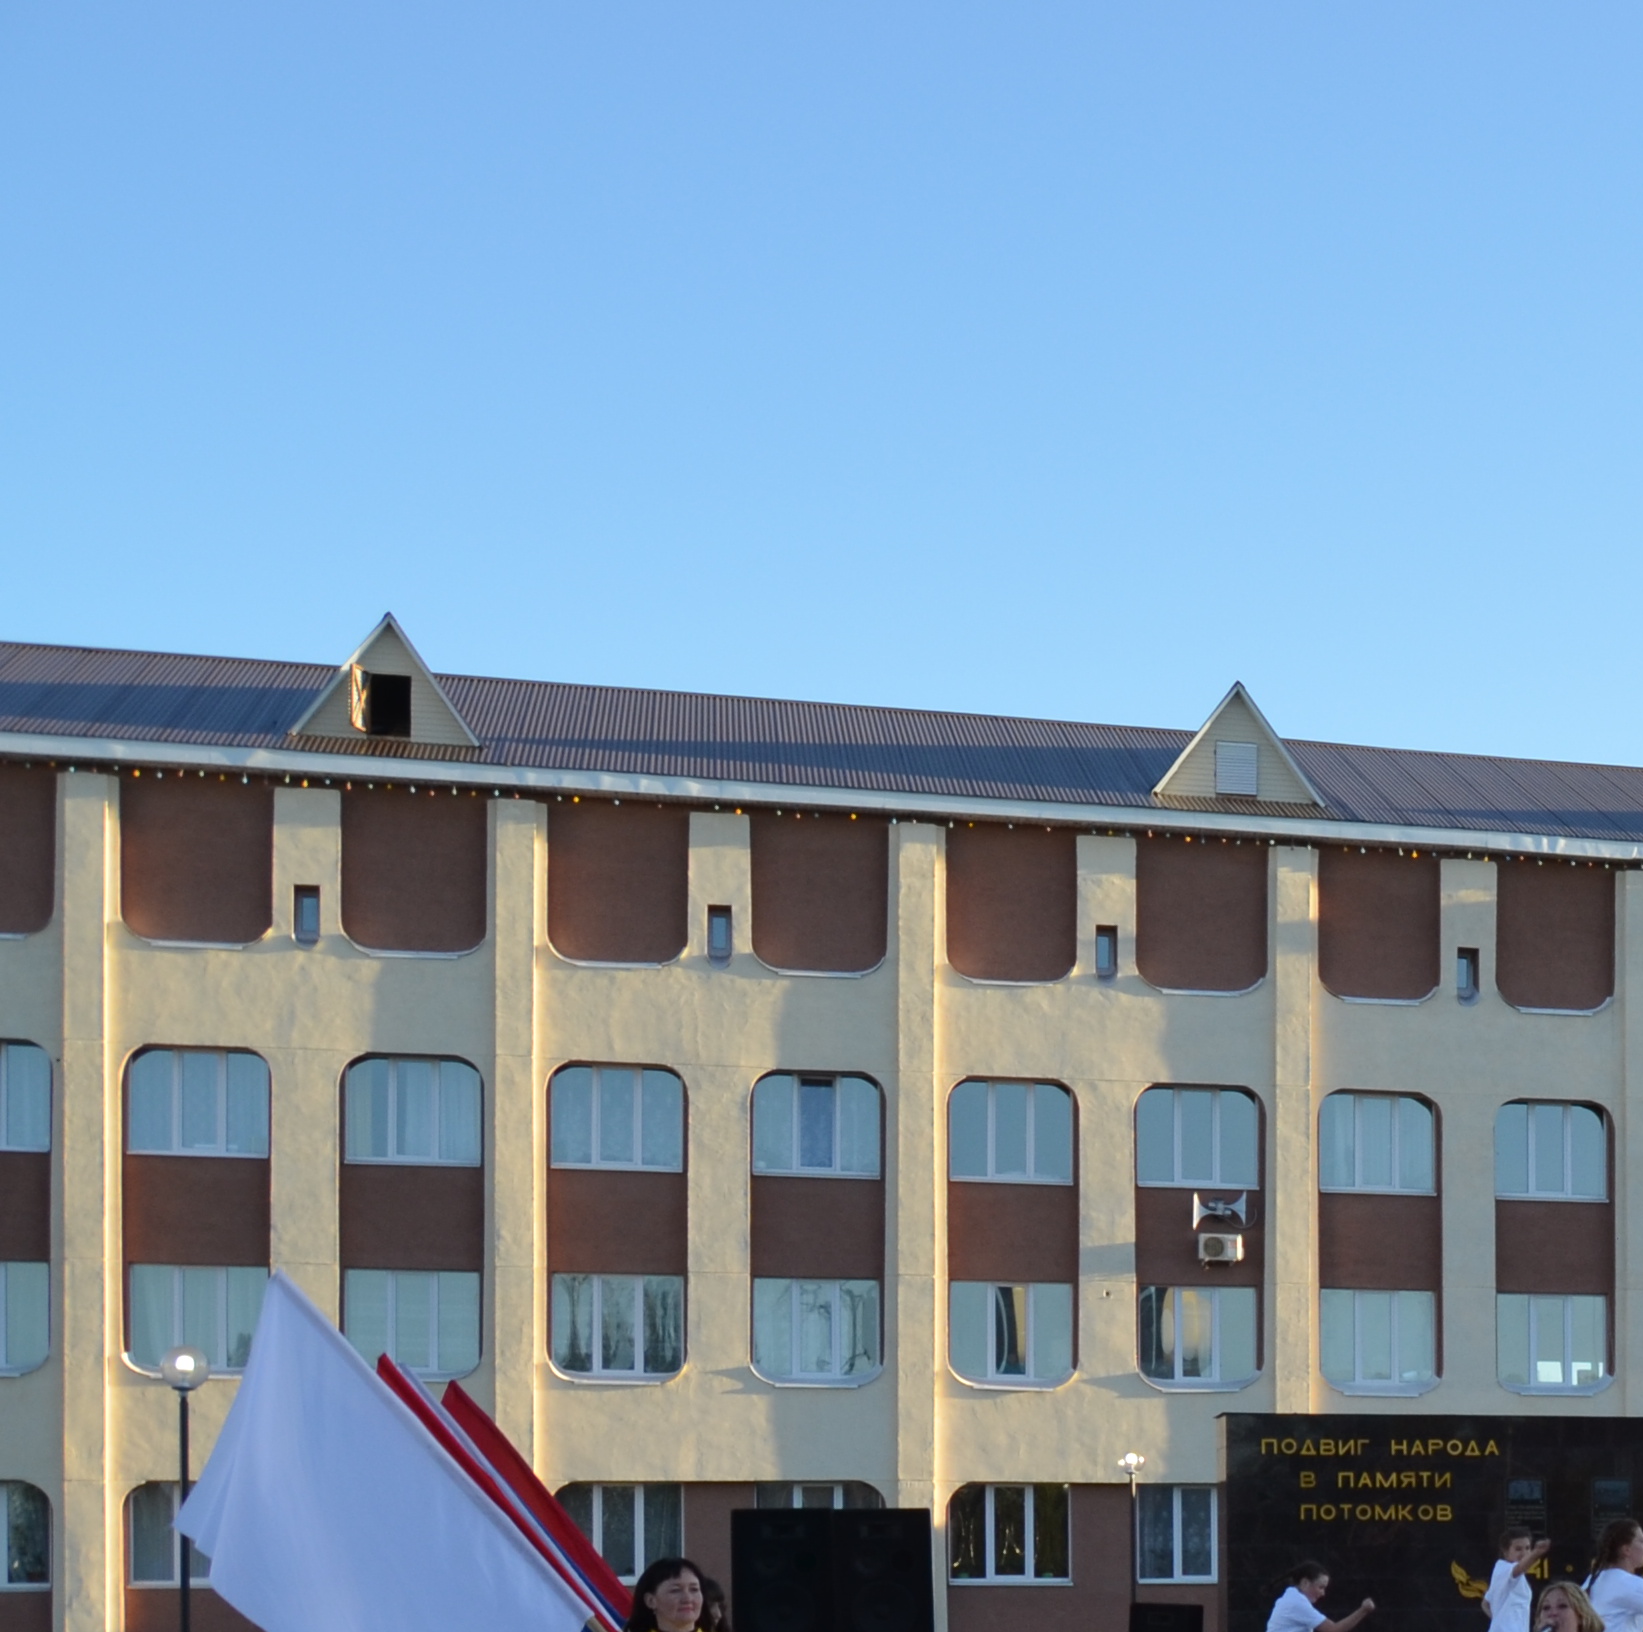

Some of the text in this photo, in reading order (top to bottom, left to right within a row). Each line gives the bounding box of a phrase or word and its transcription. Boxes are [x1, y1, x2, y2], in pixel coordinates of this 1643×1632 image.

[1261, 1438, 1499, 1456] ПОДВИГ НАРОДА
[1301, 1471, 1451, 1488] В ПАМЯТИ
[1300, 1504, 1452, 1521] ПОТОМКОВ
